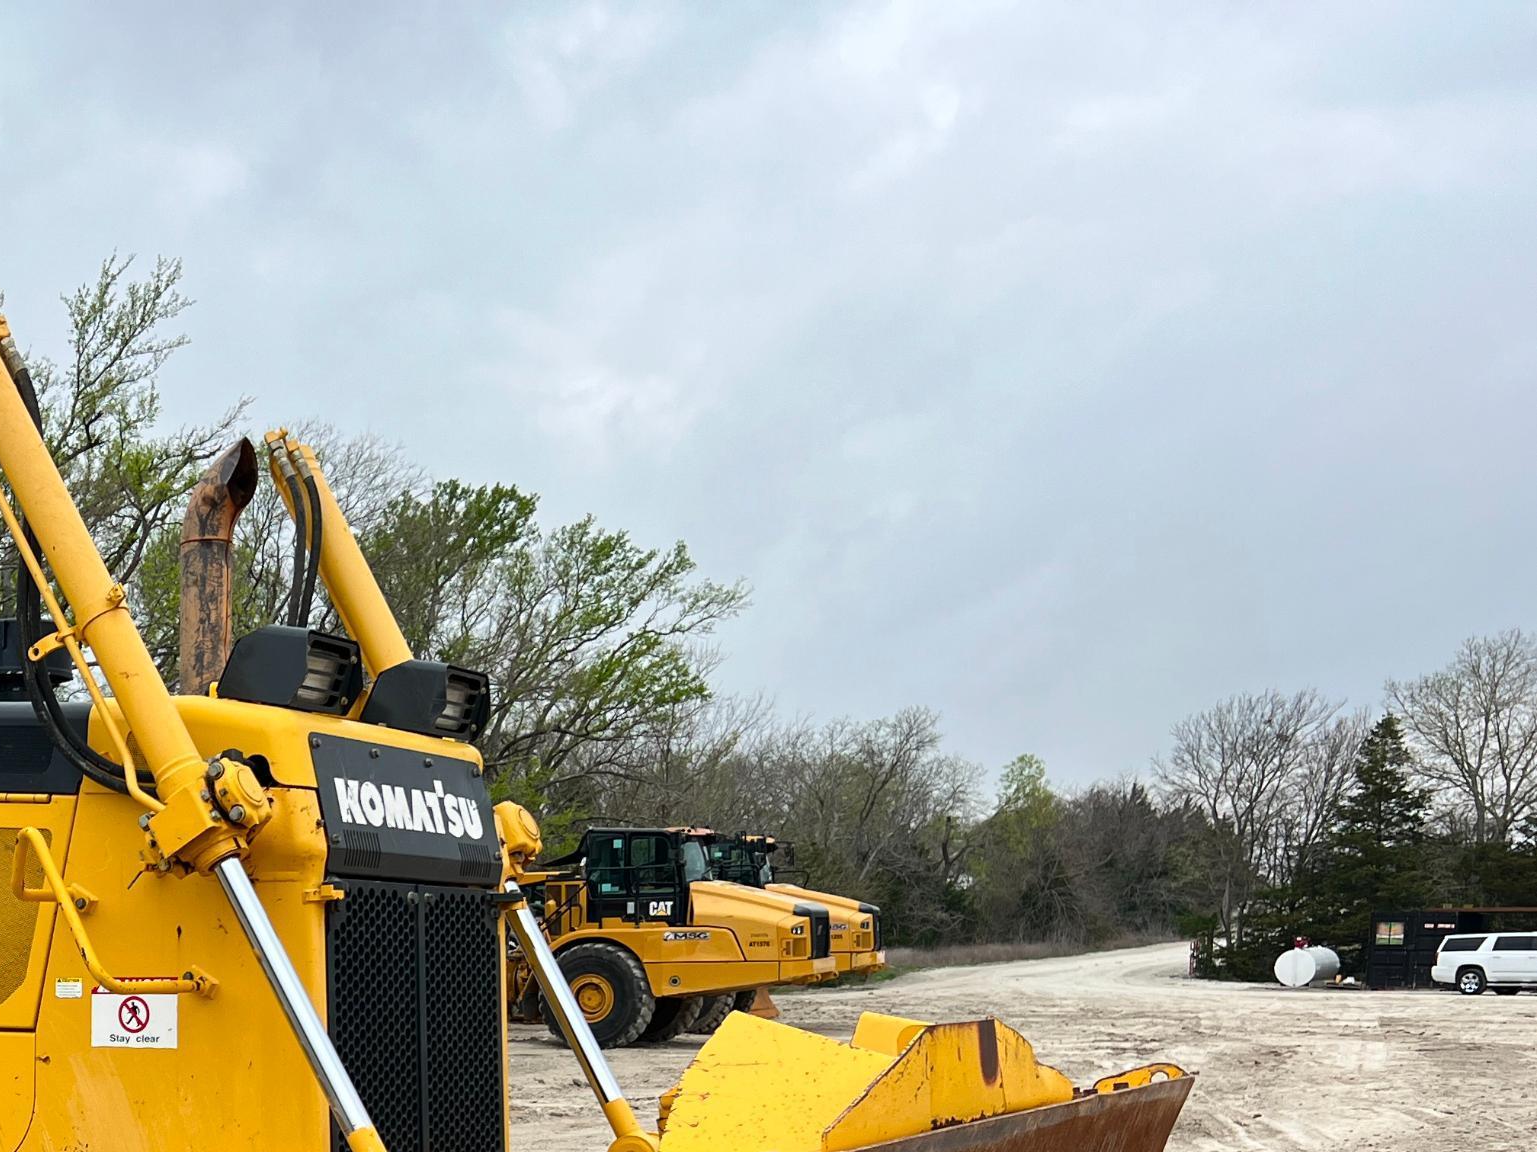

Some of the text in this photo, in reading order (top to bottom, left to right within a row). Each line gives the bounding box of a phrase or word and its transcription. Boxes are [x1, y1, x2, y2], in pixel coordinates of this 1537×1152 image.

[334, 777, 483, 840] KOMATSU
[649, 901, 674, 916] CAT
[673, 931, 709, 940] MSG
[109, 1033, 160, 1044] Stay clear
